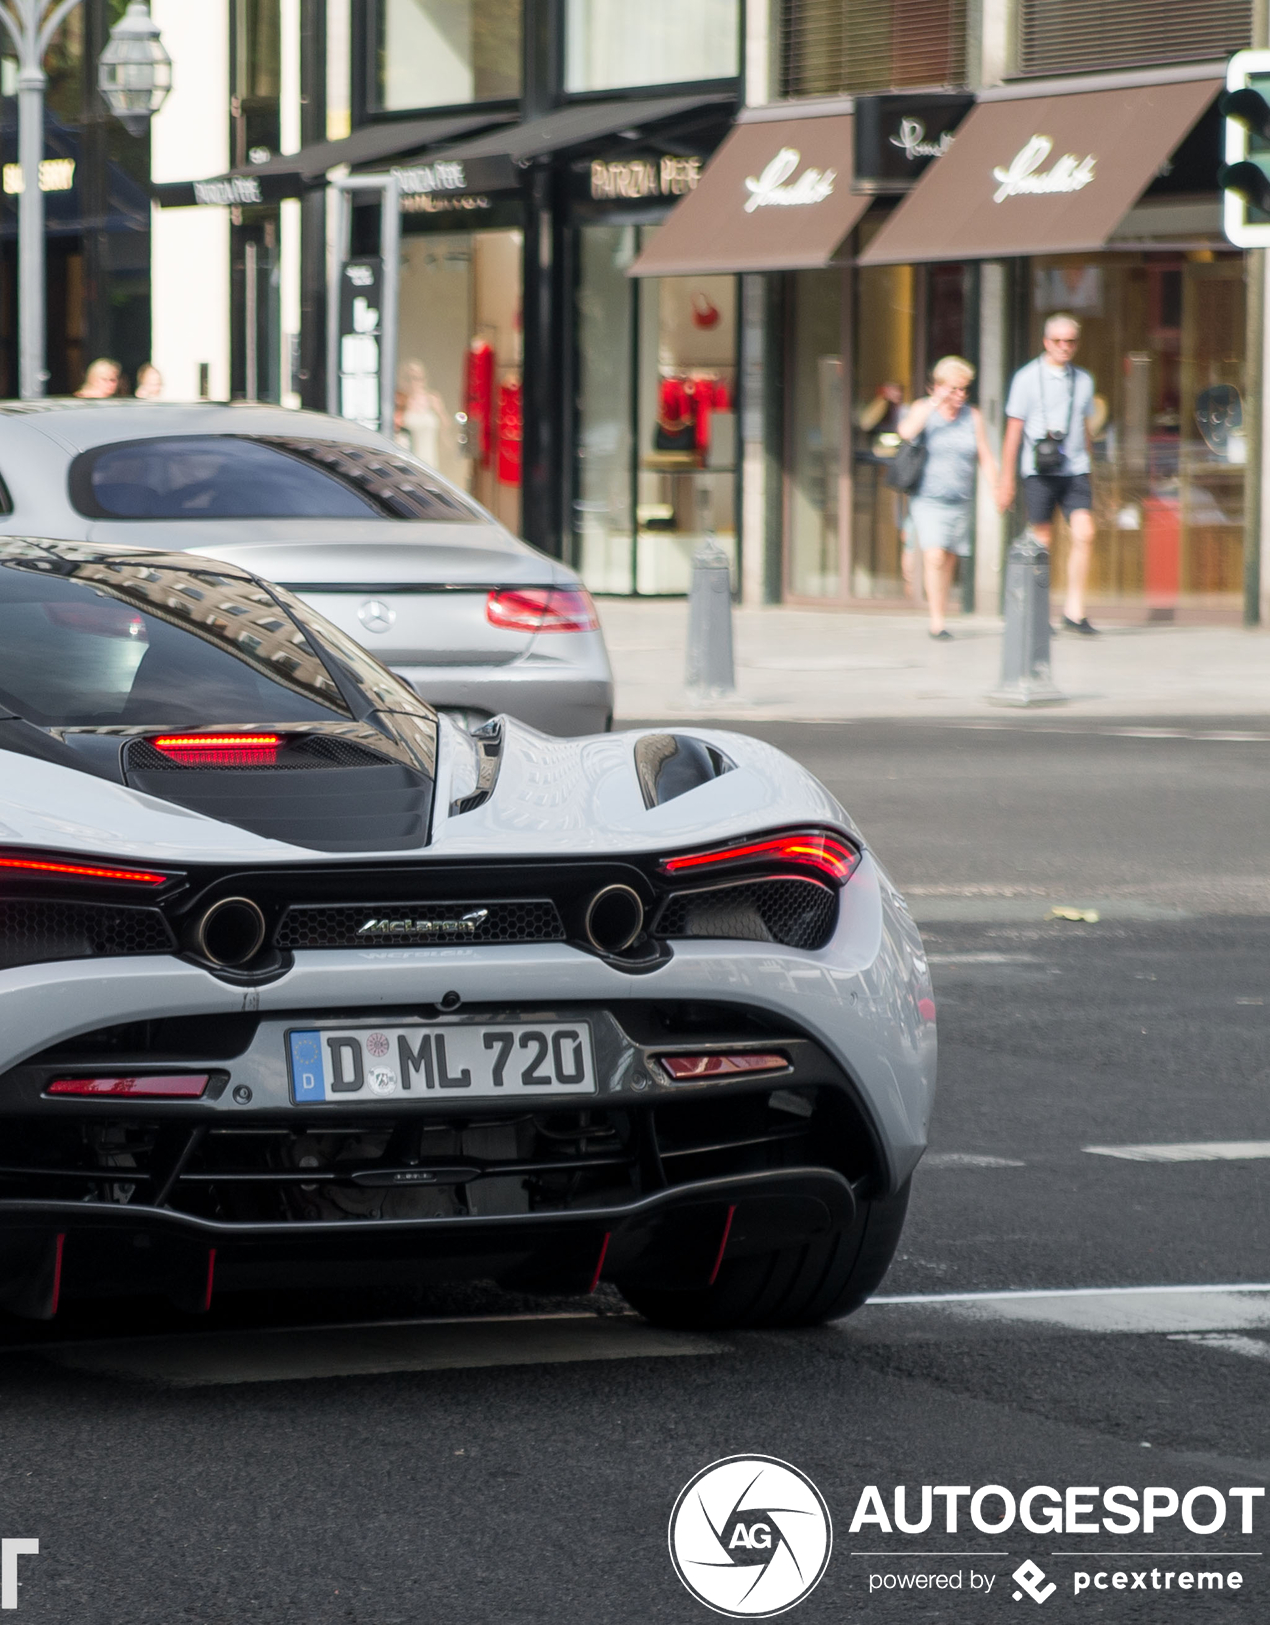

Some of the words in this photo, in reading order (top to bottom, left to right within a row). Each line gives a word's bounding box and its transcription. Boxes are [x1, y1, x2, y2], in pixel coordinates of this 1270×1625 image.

[357, 912, 478, 934] McLaren
[327, 1036, 364, 1093] D
[397, 1033, 472, 1090] ML
[482, 1029, 585, 1087] 720
[303, 1073, 315, 1090] D
